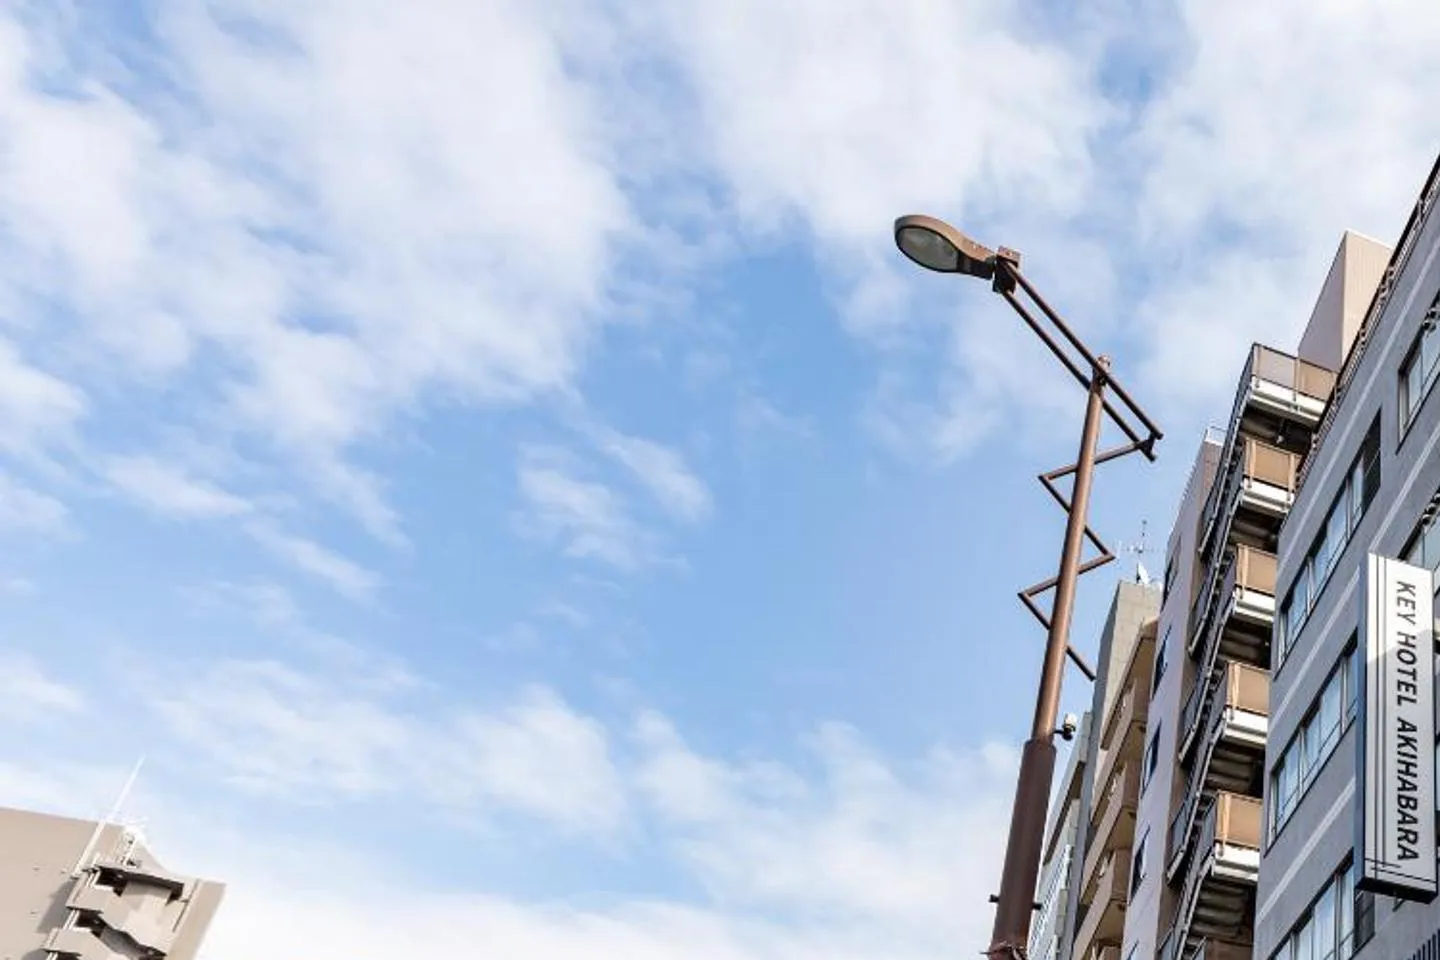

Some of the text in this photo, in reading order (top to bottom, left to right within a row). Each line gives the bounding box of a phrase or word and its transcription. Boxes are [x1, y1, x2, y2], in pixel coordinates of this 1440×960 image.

[1396, 581, 1420, 861] KEY HOTEL AKIHABARA
